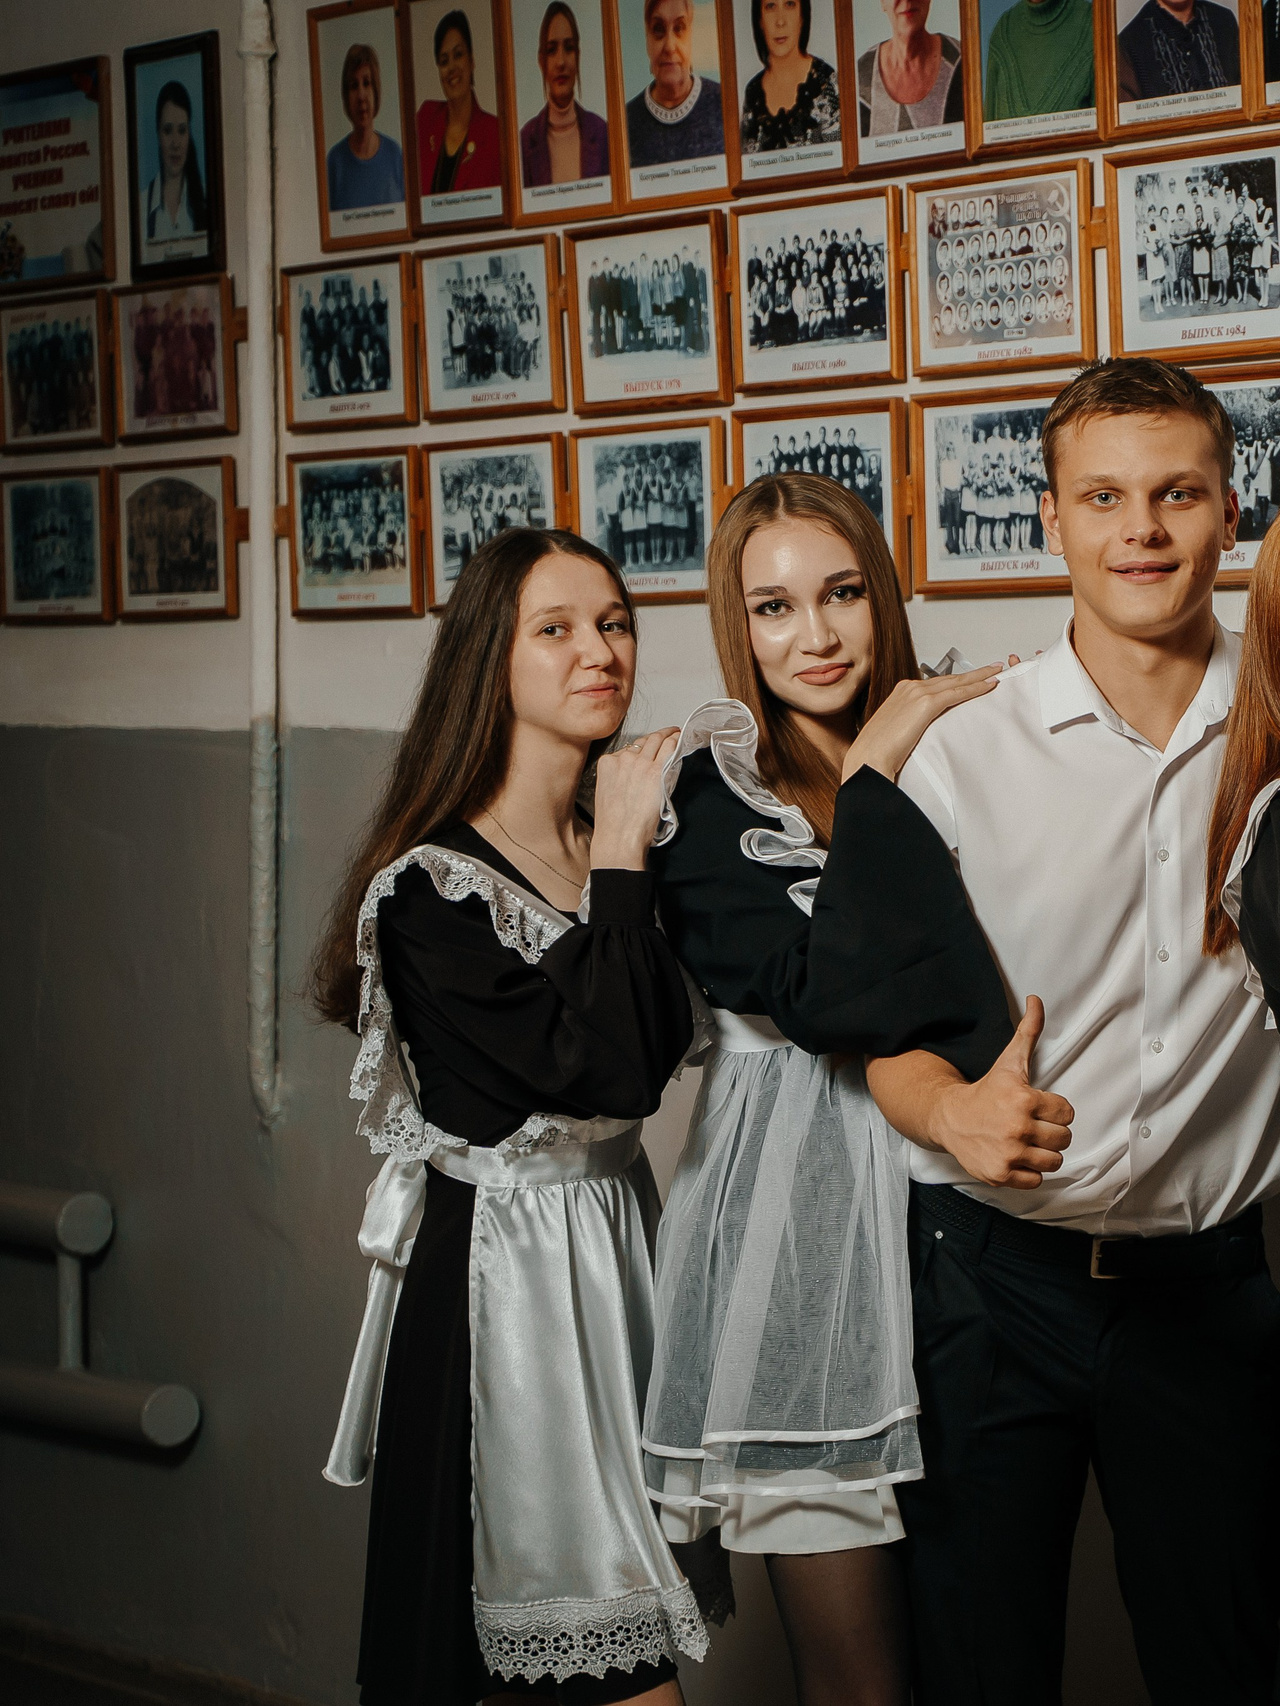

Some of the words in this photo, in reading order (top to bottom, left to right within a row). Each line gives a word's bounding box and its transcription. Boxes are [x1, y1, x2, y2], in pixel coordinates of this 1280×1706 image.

[1181, 326, 1224, 340] ВЫПУСК
[1225, 324, 1246, 336] 1984
[977, 348, 1012, 360] ВЫПУСК
[1014, 346, 1032, 357] 1982
[792, 360, 827, 371] ВЫПУСК
[828, 359, 846, 369] 1980
[624, 380, 662, 393] ВЫПУСК
[1225, 550, 1245, 562] 1985
[980, 560, 1019, 571] ВЫПУСК
[1020, 559, 1040, 570] 1983
